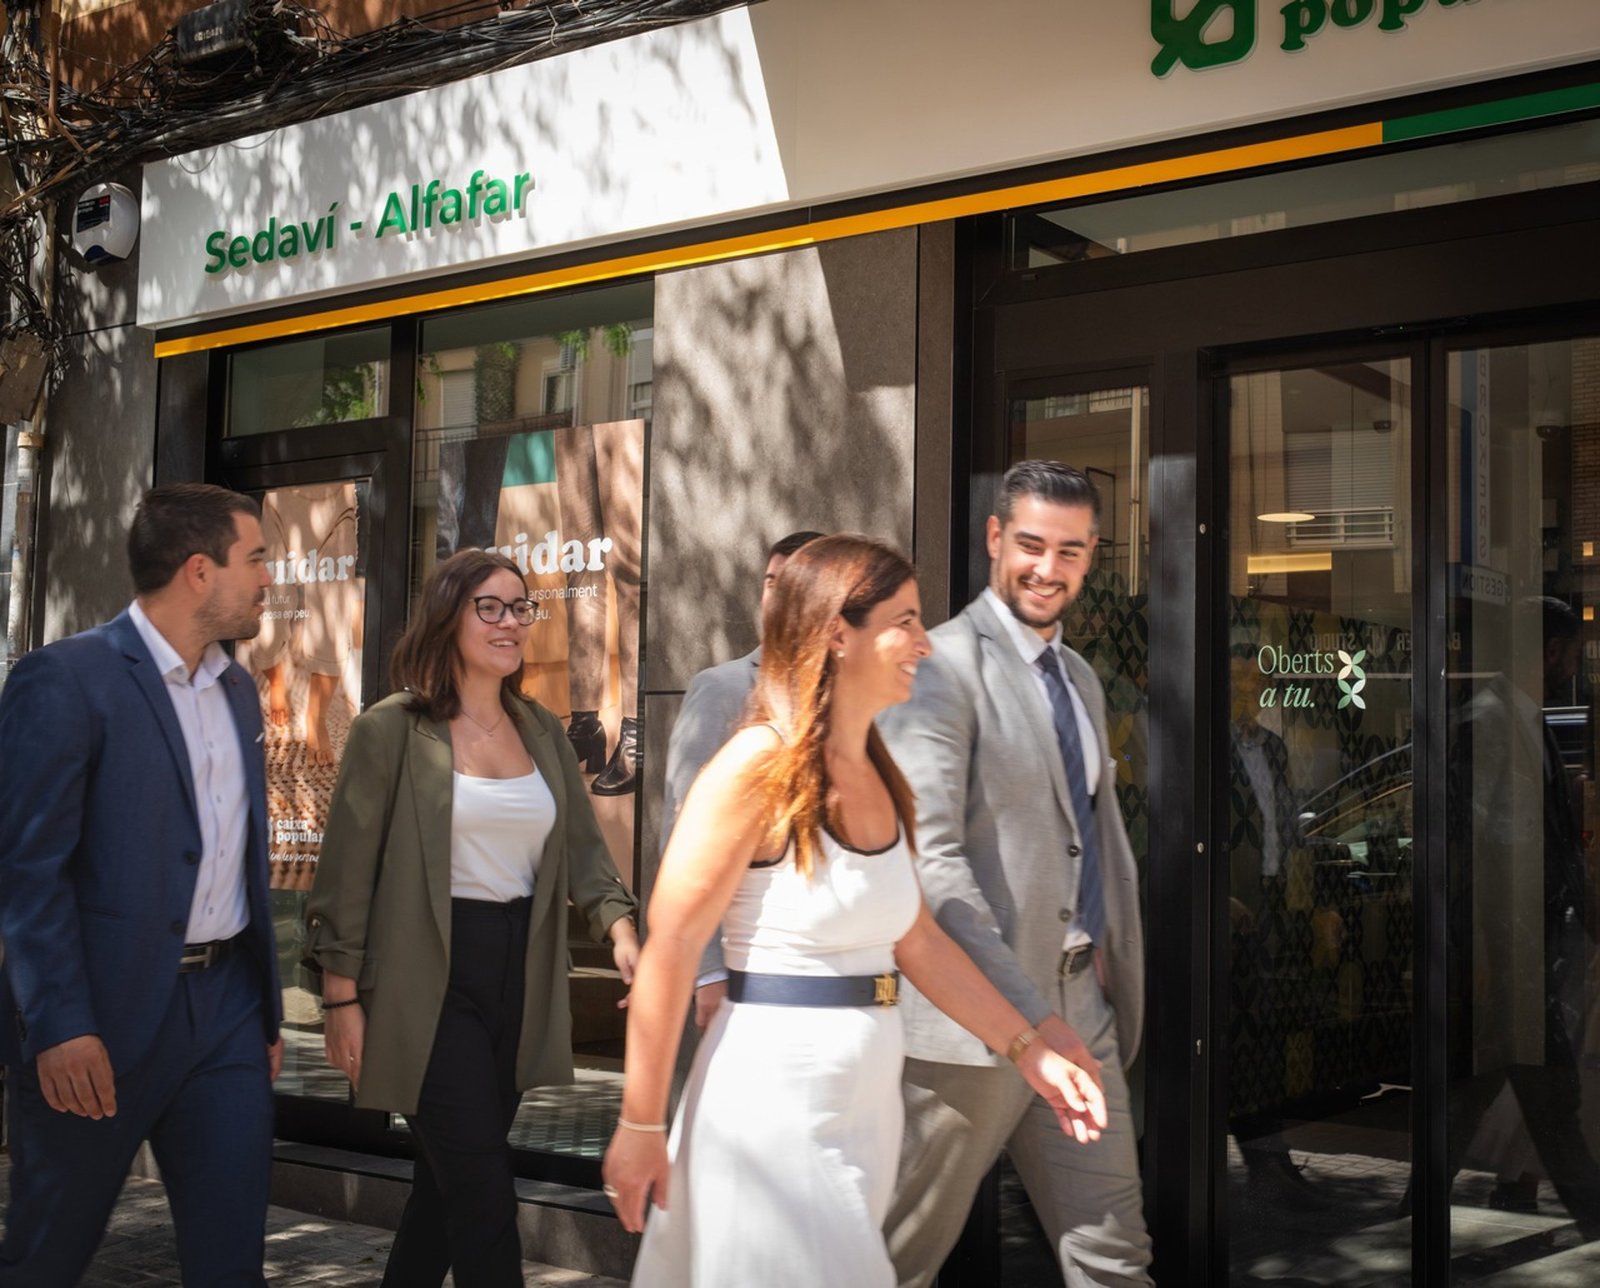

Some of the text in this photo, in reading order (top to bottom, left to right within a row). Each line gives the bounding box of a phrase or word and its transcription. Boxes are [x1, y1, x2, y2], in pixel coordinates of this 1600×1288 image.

[204, 202, 338, 274] Sedaví
[375, 170, 532, 239] Alfafar
[265, 549, 355, 585] uidar
[527, 584, 598, 601] ersonalment
[1257, 645, 1335, 675] Oberts
[1259, 683, 1316, 708] a tu.
[277, 816, 308, 830] caixa
